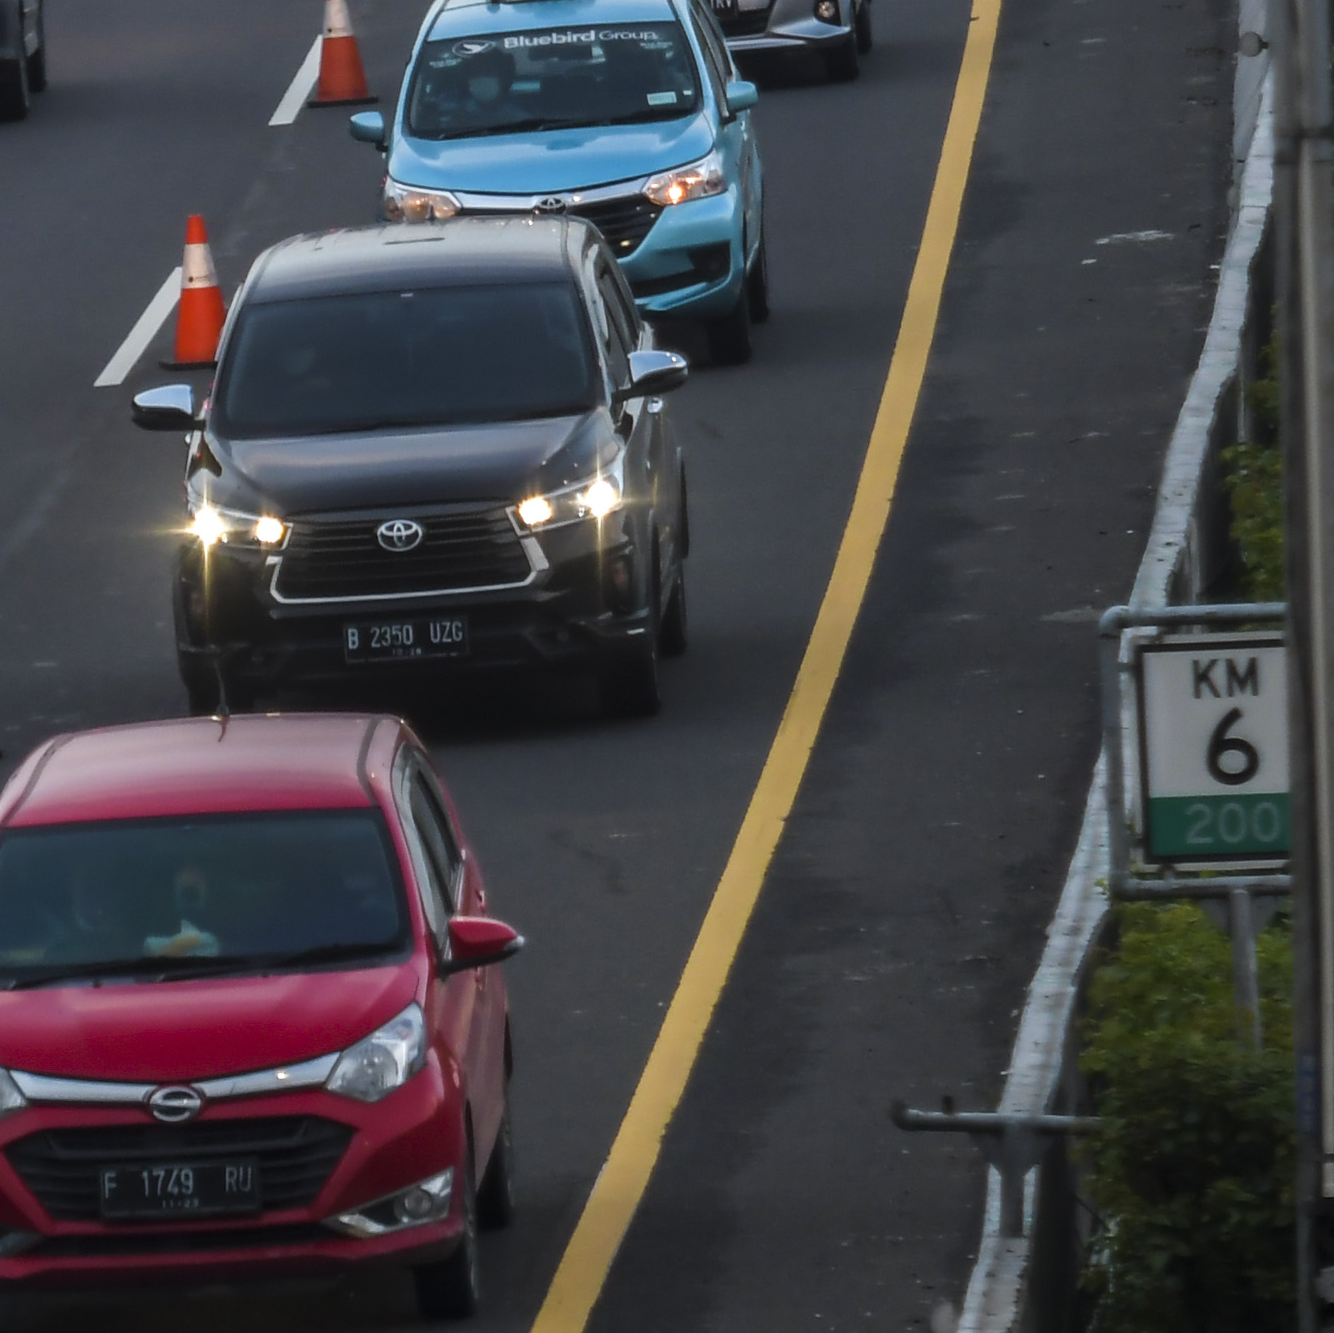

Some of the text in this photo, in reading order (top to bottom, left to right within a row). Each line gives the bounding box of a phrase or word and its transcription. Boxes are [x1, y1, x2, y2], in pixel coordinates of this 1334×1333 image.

[503, 28, 657, 50] Bluebird Group
[347, 621, 463, 650] B 2350 UZG
[1192, 656, 1260, 700] KM
[1206, 707, 1261, 786] 6
[1185, 801, 1282, 846] 200
[103, 1165, 252, 1198] F 1749 RU
